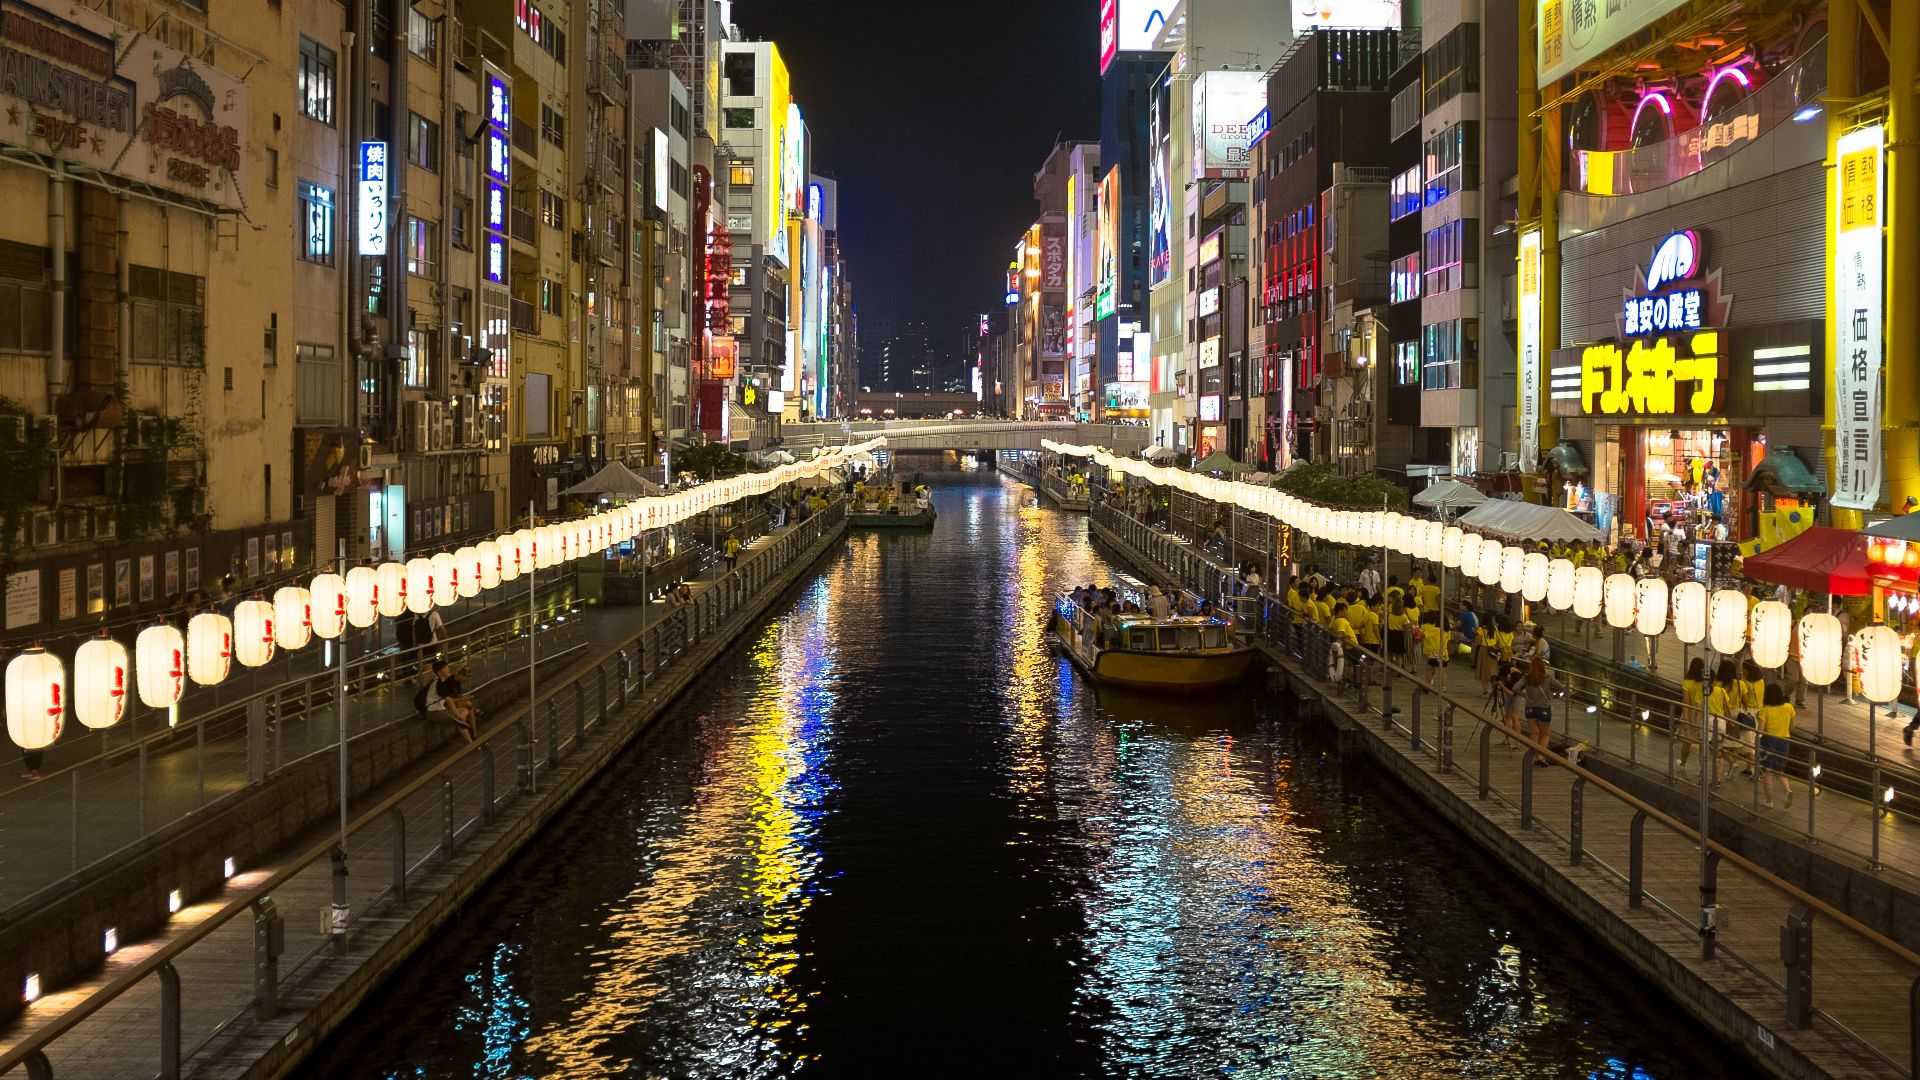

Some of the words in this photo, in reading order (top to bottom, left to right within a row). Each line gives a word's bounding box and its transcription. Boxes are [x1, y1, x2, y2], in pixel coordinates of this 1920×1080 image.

[0, 44, 130, 132] AINSTREET
[367, 145, 384, 180] 焼肉
[368, 185, 383, 251] いろりや
[1047, 237, 1062, 287] スポタカ
[1625, 290, 1700, 334] 激安の殿堂
